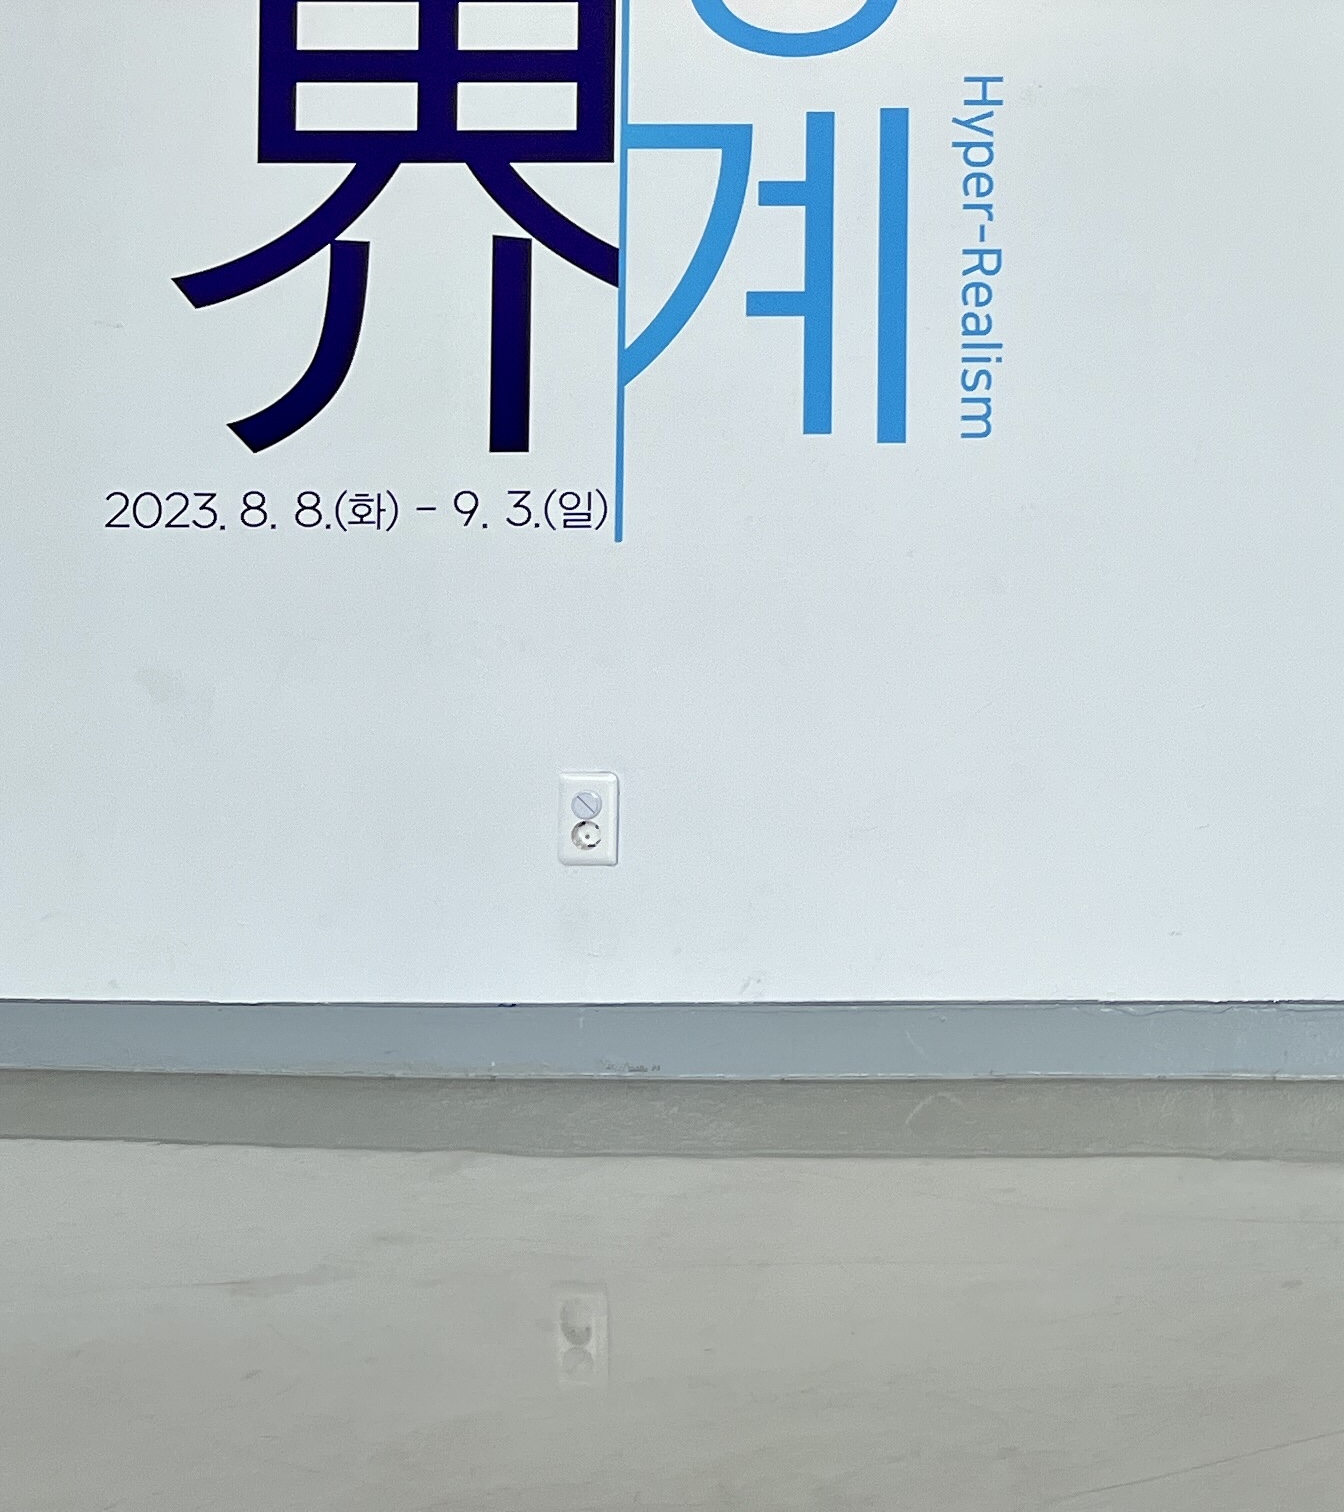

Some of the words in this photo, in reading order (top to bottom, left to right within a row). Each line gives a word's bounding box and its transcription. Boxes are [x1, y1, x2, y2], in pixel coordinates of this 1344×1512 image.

[951, 76, 1004, 439] Hyper-Realism
[104, 491, 226, 531] 2023.
[240, 490, 277, 530] 8.
[294, 488, 399, 532] 8.(화)
[453, 490, 488, 529] 9.
[506, 488, 608, 531] 3.(일)
